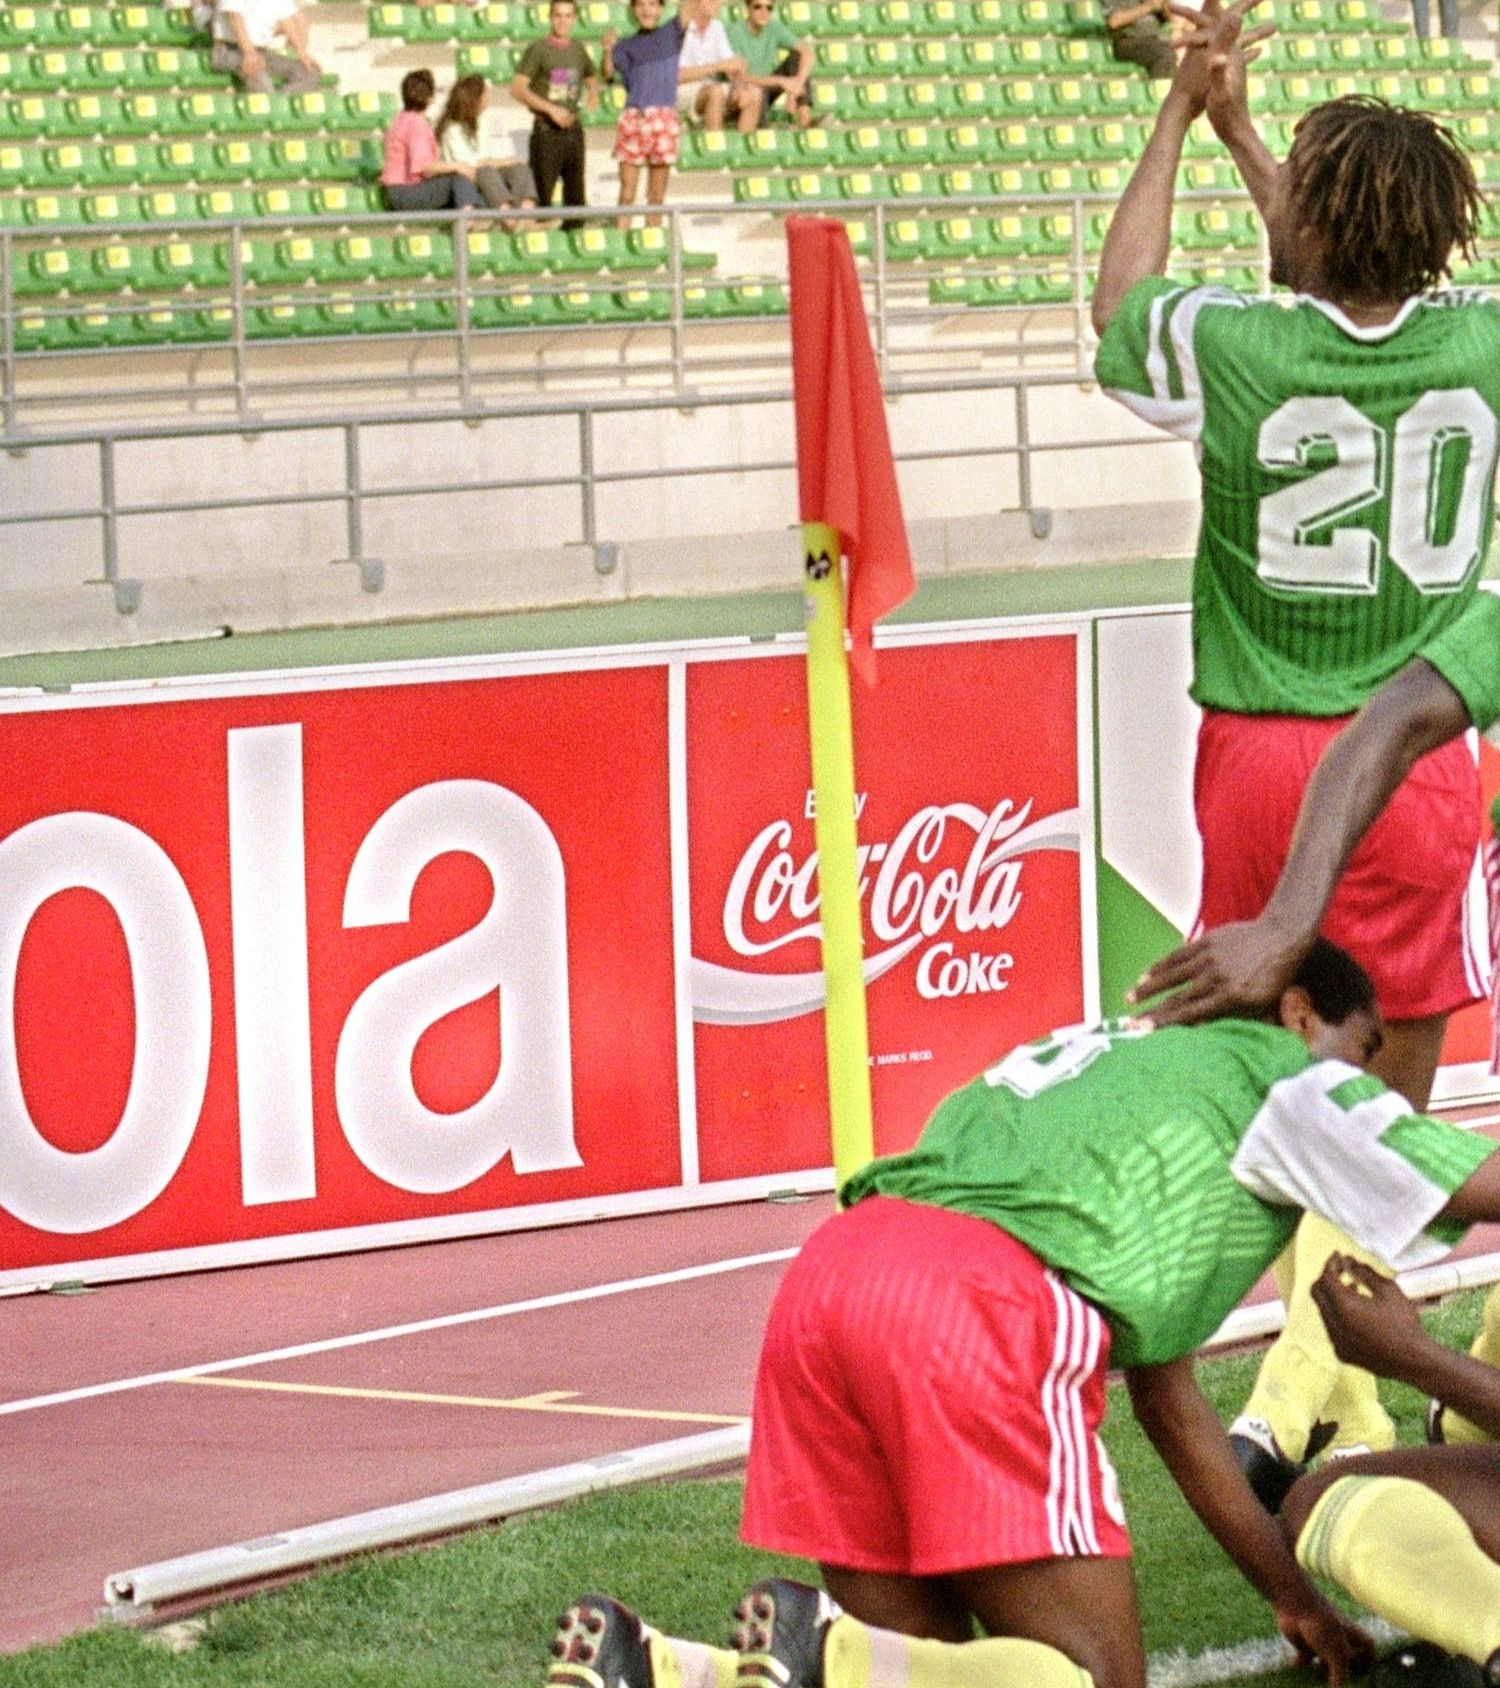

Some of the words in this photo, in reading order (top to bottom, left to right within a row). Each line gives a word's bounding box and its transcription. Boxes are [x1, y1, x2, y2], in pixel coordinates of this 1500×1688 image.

[1257, 387, 1498, 596] 20
[723, 796, 1034, 956] Coc-Cola
[916, 942, 1014, 999] Coke
